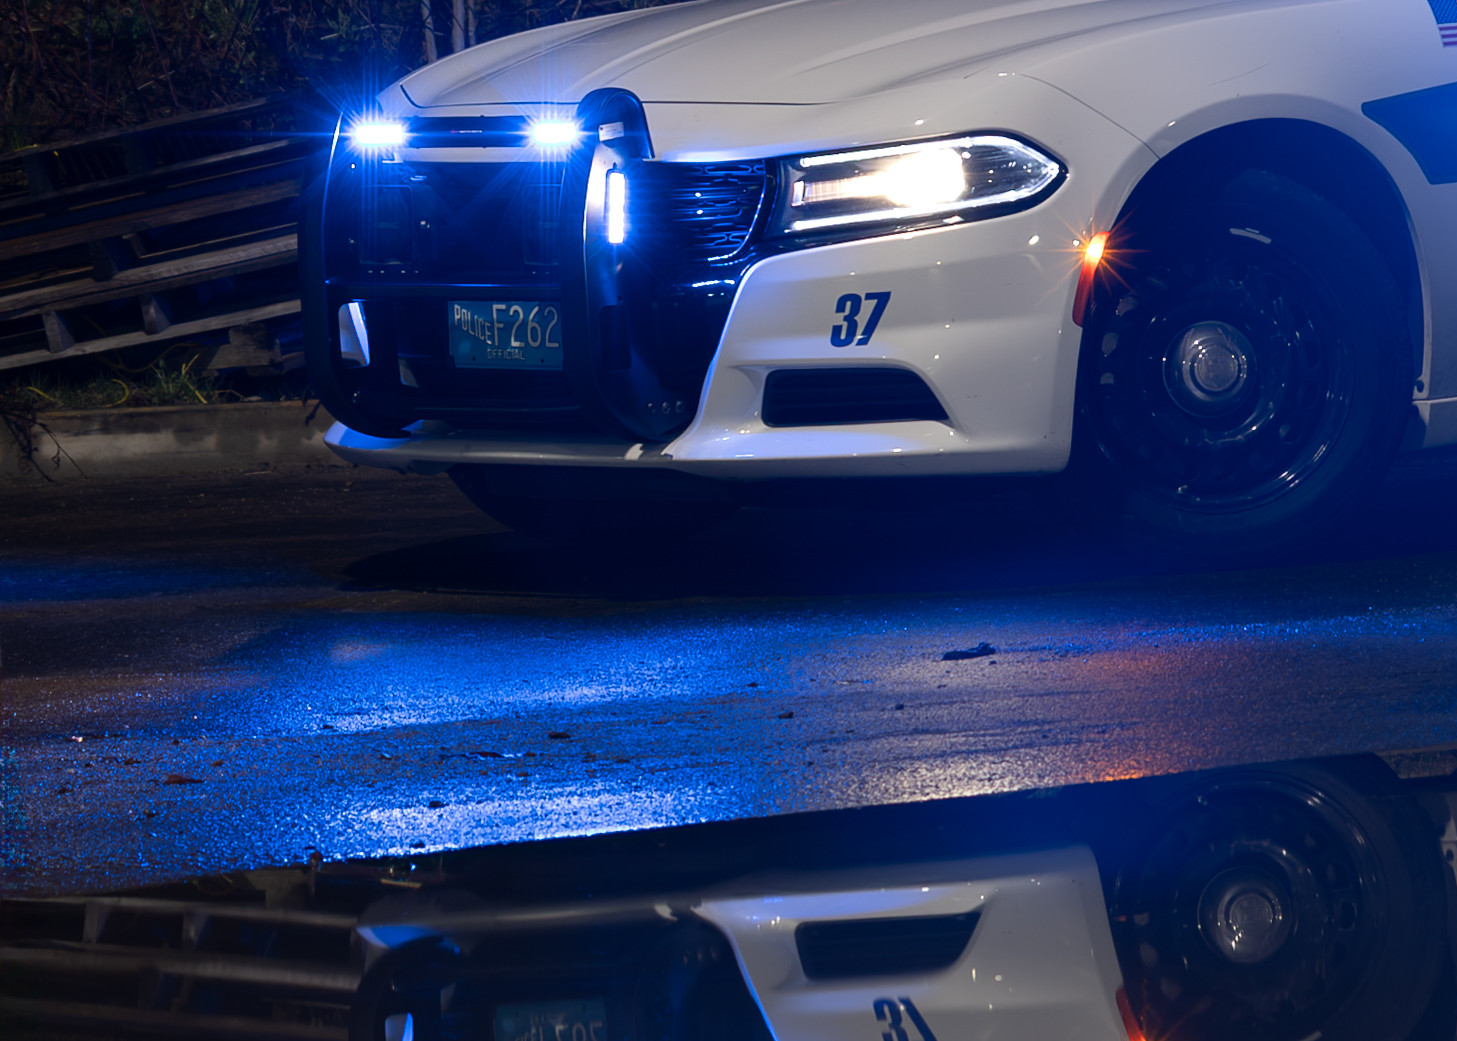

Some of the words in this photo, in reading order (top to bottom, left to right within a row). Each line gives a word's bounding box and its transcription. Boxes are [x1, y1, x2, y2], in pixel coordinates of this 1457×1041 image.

[453, 303, 493, 345] POLICE
[492, 303, 560, 348] F262
[830, 290, 892, 348] 37
[487, 348, 525, 360] OFFICIAL
